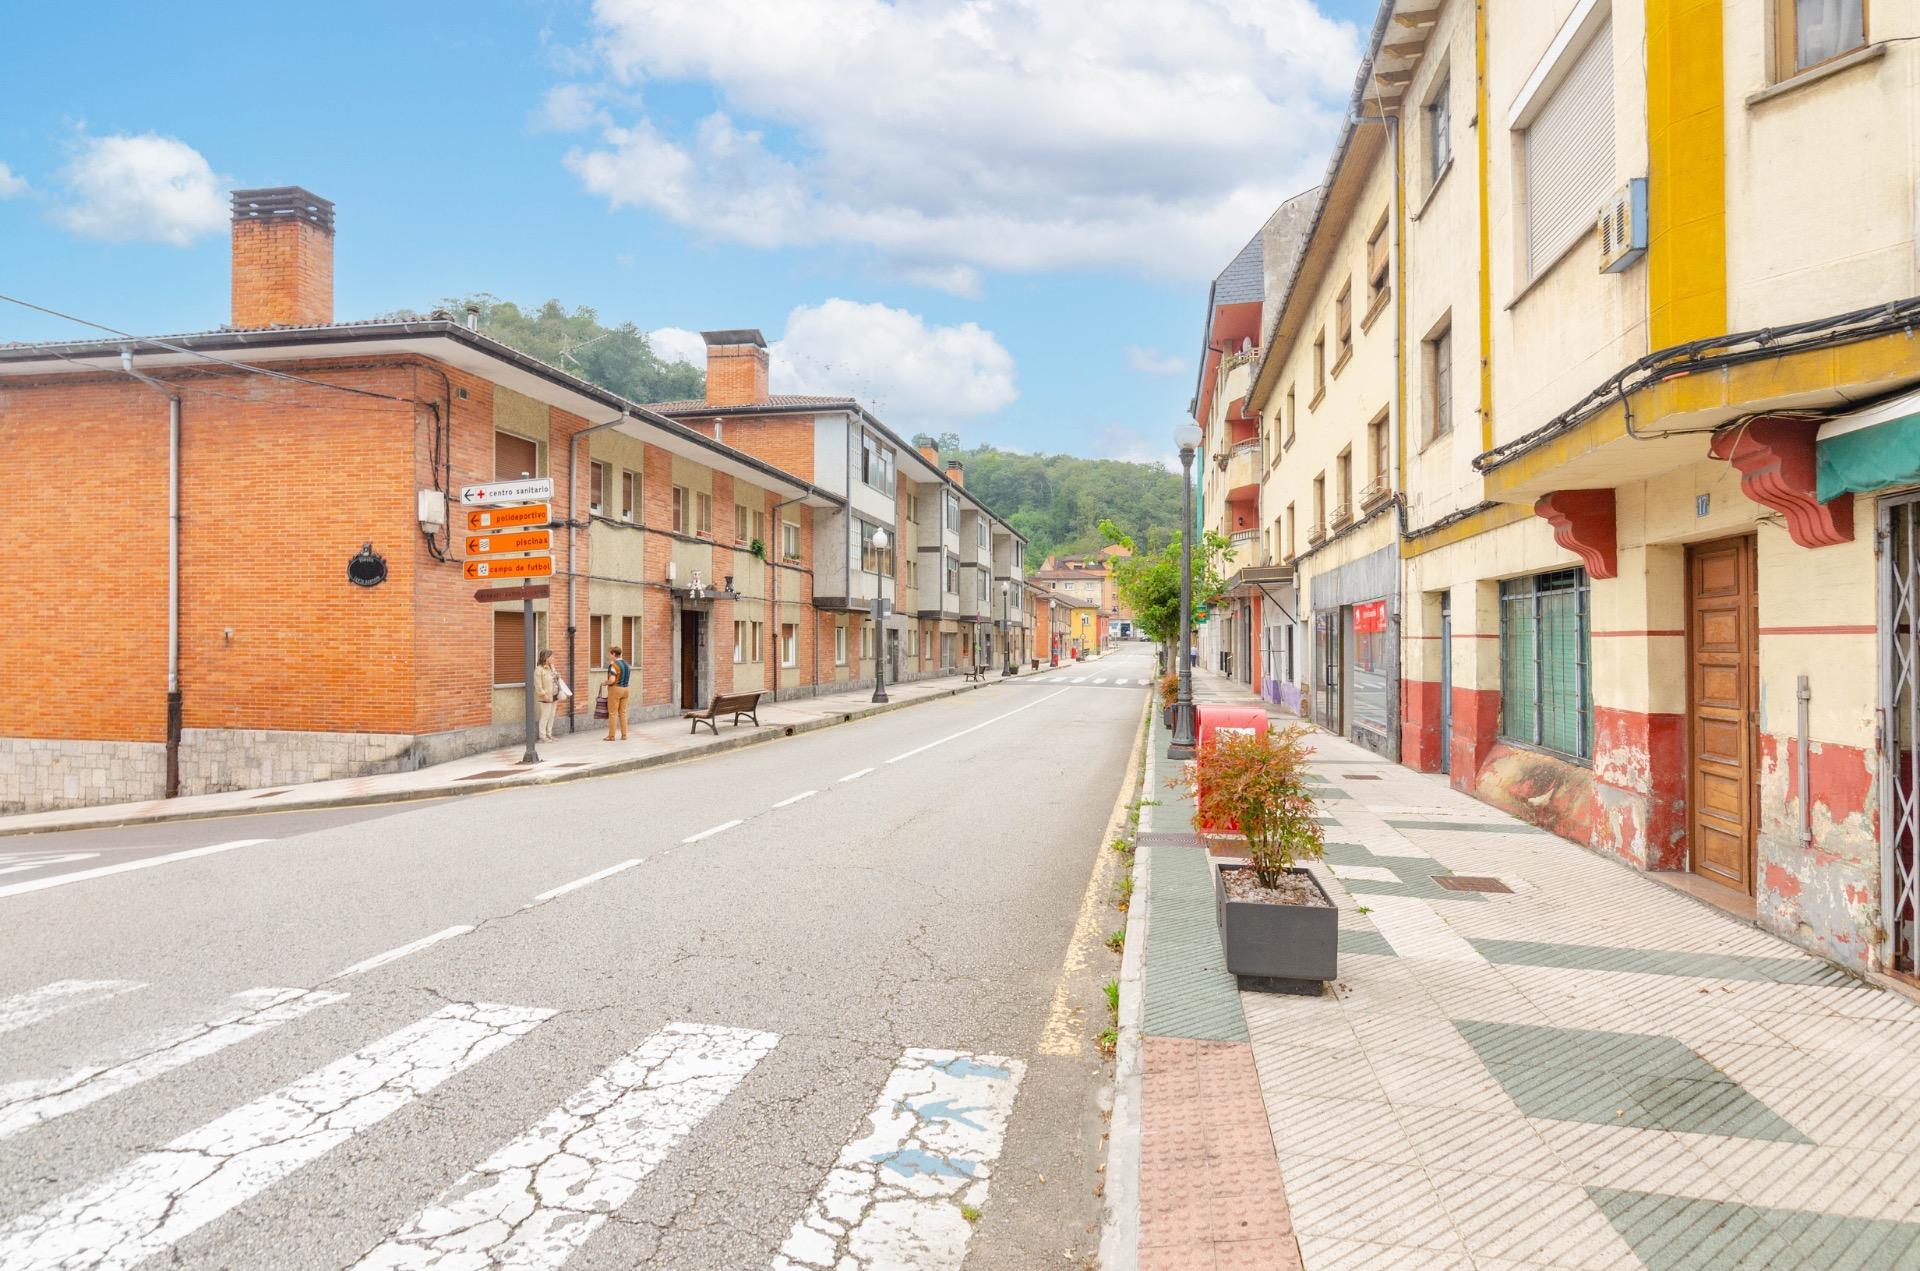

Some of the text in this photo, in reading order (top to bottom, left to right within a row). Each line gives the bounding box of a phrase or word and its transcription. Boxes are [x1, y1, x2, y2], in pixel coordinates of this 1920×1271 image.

[516, 485, 549, 494] sanitario
[496, 511, 546, 523] polideportivo
[516, 537, 548, 547] piscinas
[516, 564, 524, 572] de
[527, 563, 551, 571] futbol
